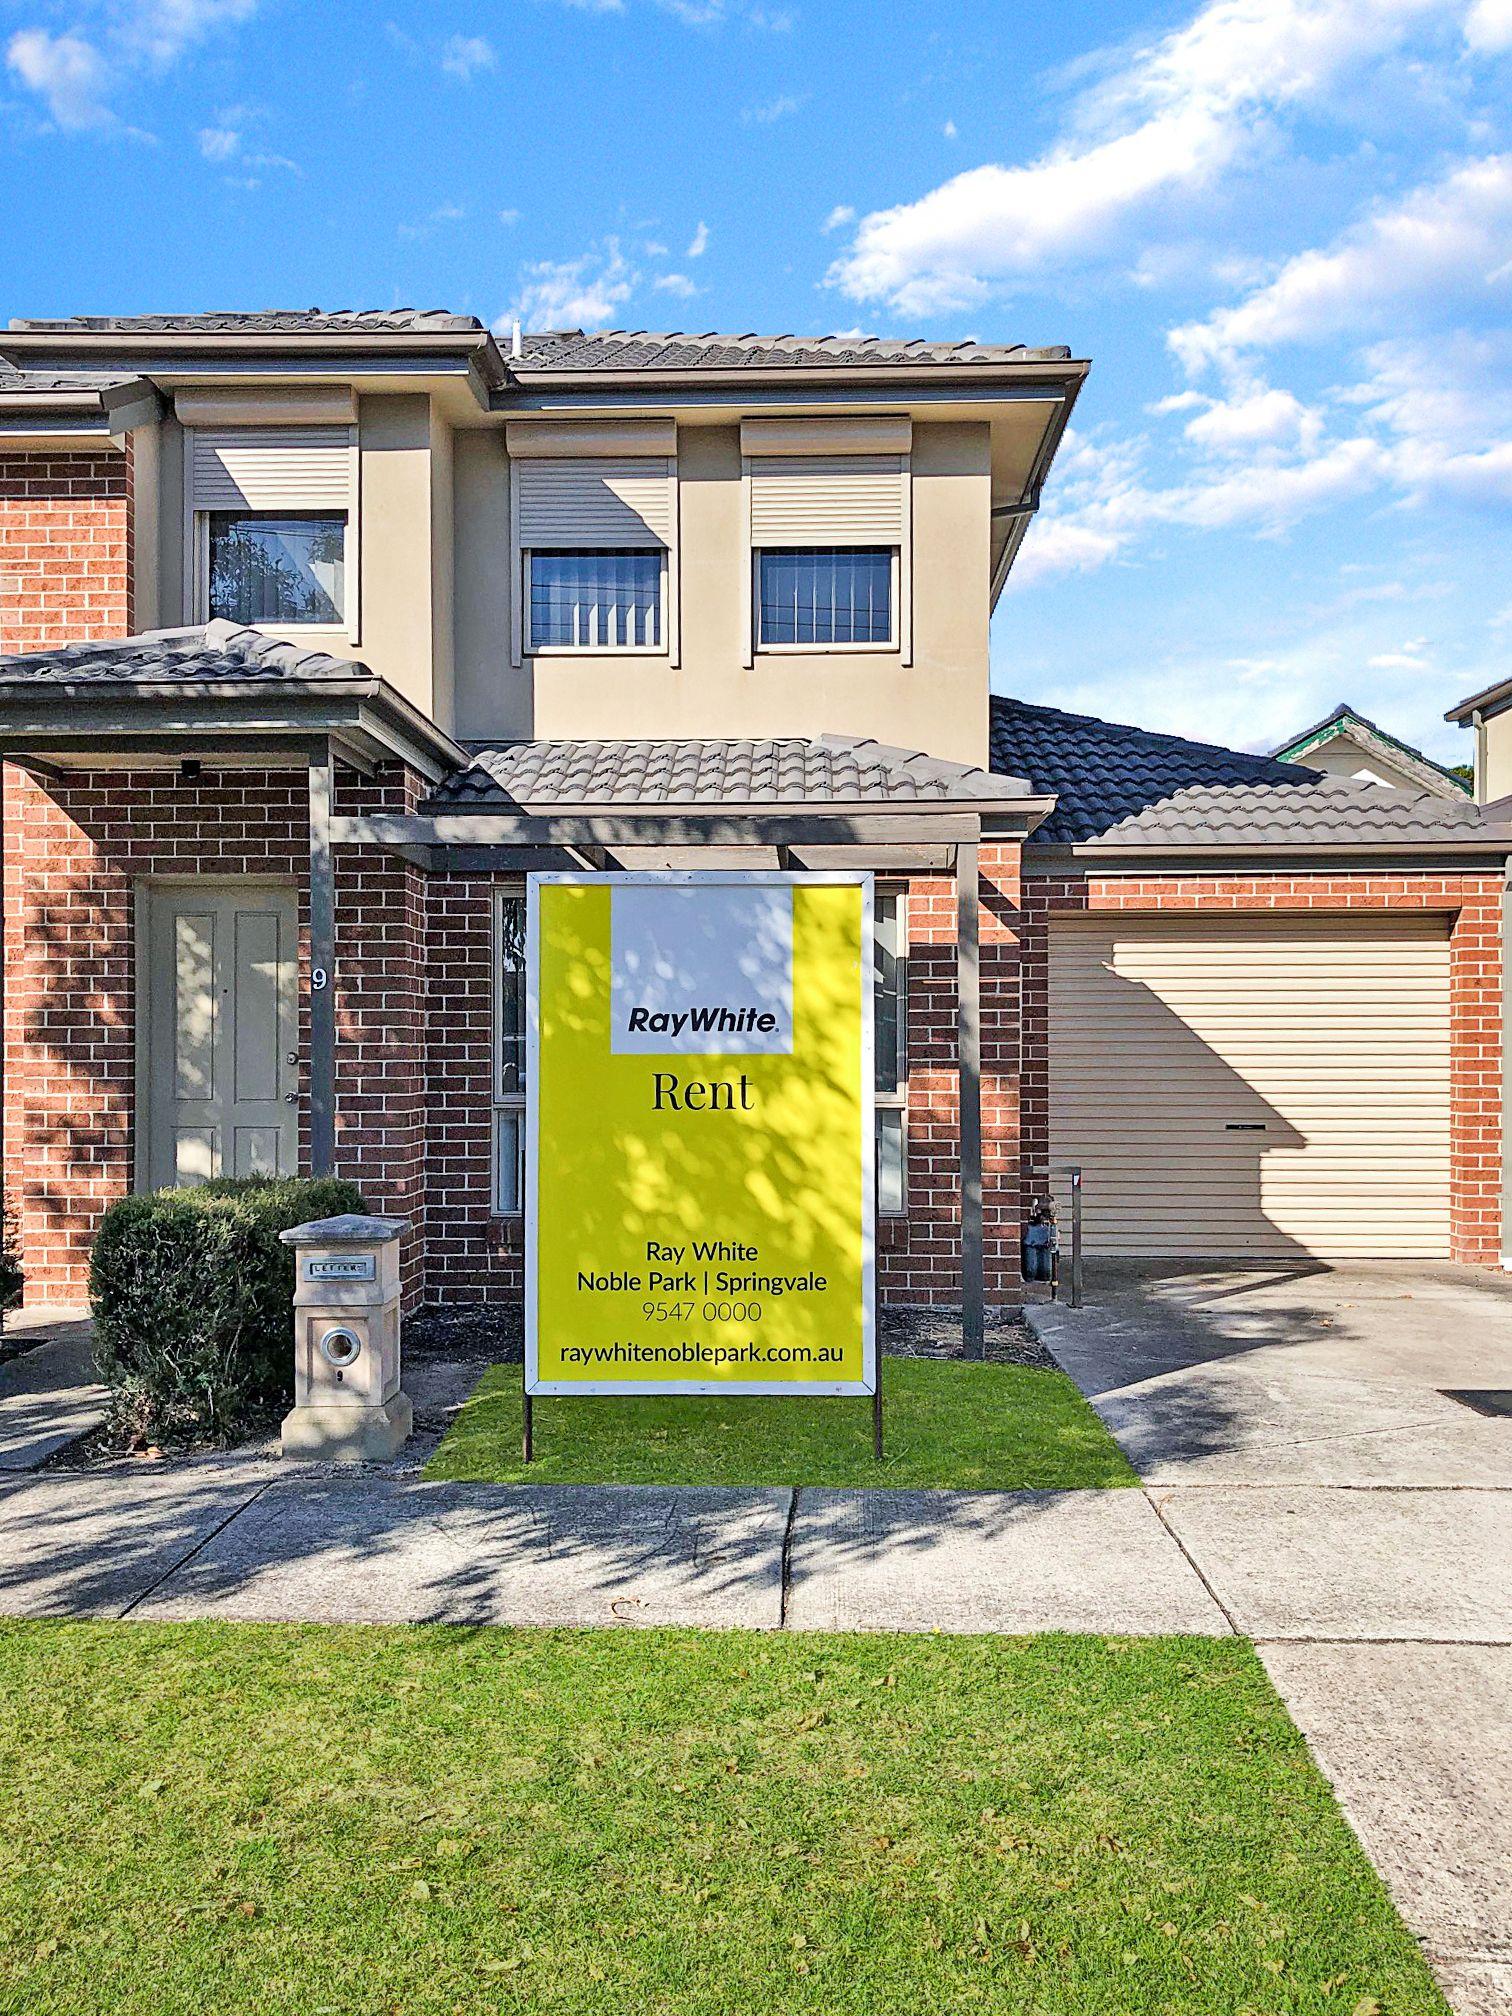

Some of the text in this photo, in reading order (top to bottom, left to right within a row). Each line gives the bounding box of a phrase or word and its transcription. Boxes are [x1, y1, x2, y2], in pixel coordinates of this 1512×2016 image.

[312, 968, 327, 990] 9
[651, 1072, 755, 1111] Rent
[646, 1241, 759, 1265] Ray White
[577, 1271, 642, 1292] Noble
[649, 1271, 697, 1292] Park
[715, 1271, 828, 1296] Springvale
[642, 1301, 762, 1322] 9547 0000
[560, 1342, 844, 1366] raywhitenoblepark.com.au
[336, 1370, 344, 1382] 9
